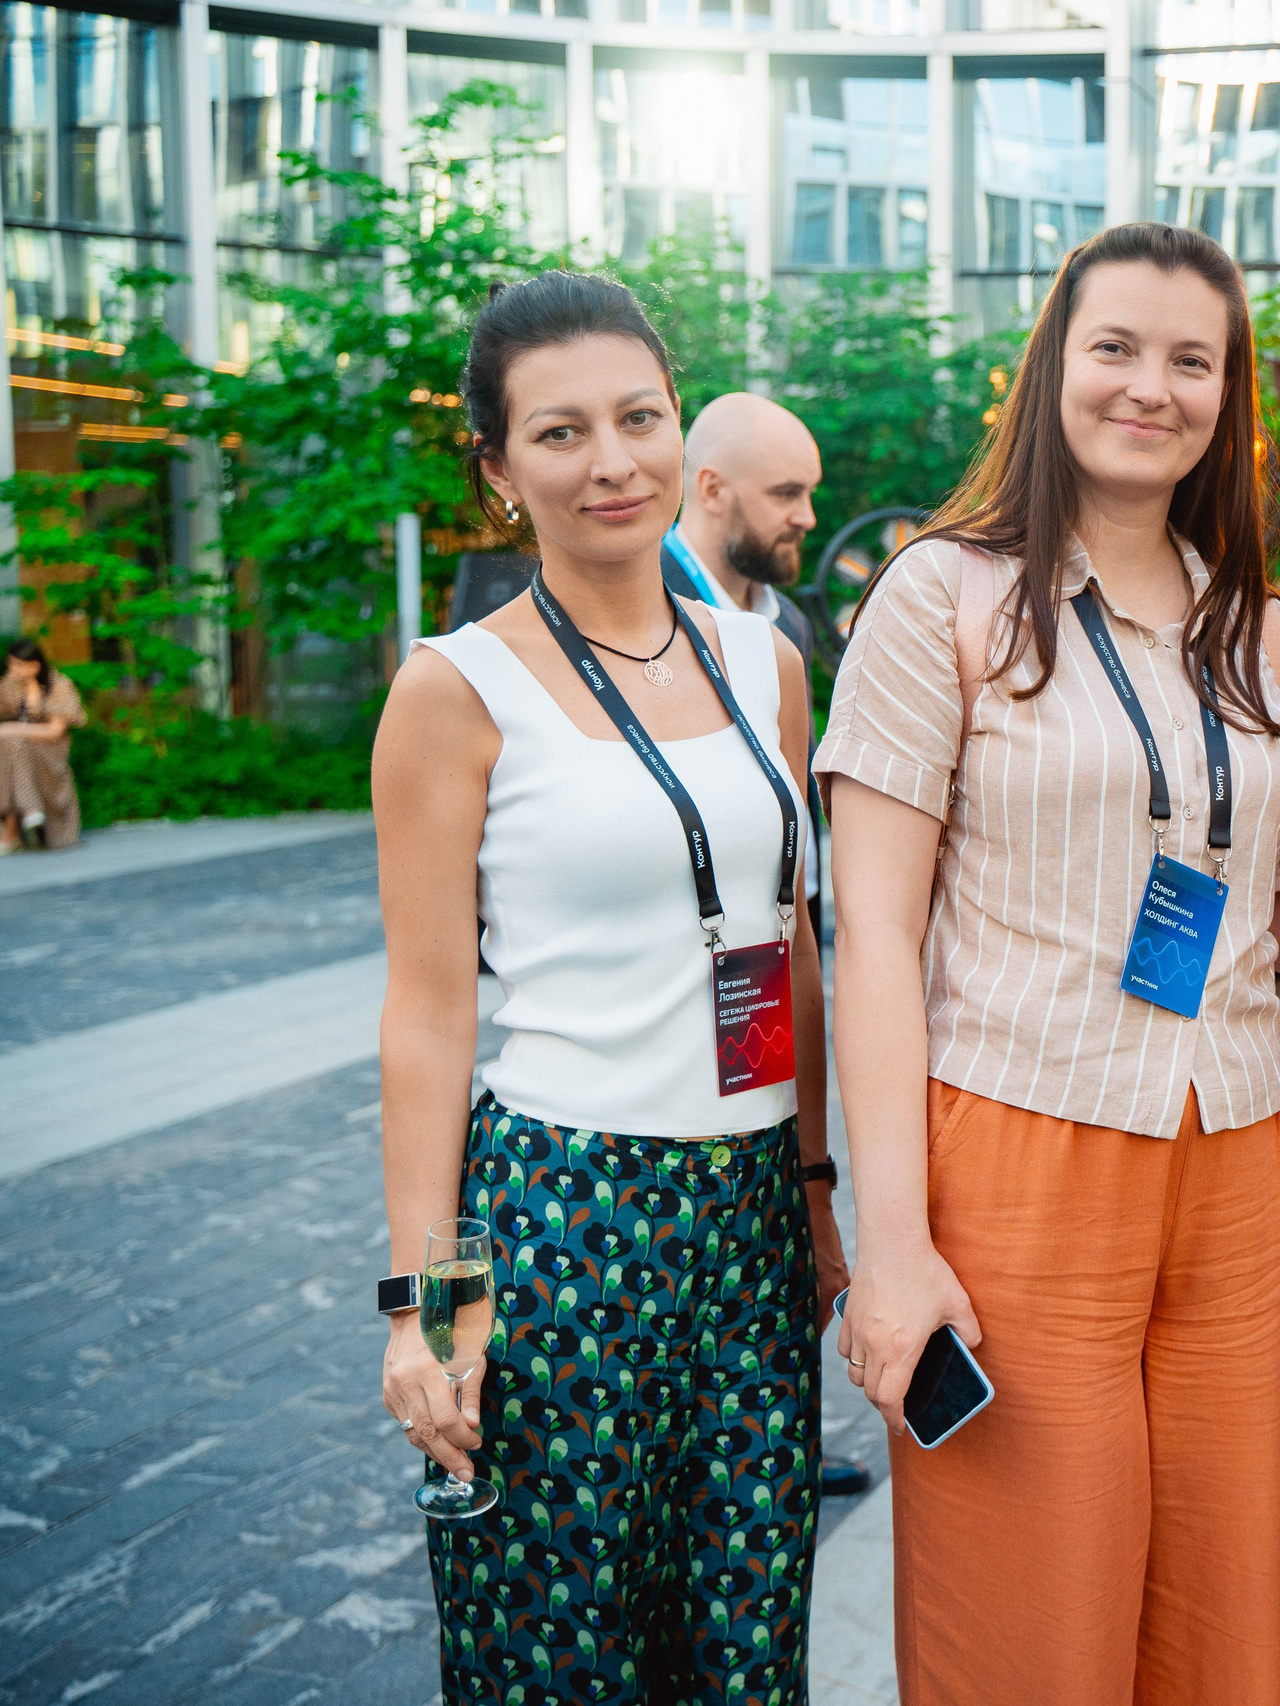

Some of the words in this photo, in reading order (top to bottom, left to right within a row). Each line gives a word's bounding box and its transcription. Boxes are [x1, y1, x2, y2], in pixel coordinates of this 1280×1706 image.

[581, 659, 606, 691] Контур
[702, 649, 720, 679] Контур
[1095, 632, 1117, 669] искусство
[1113, 669, 1131, 699] бизнеса
[626, 724, 650, 754] бизнеса
[1145, 737, 1160, 772] Контур
[648, 753, 676, 789] искусство
[1215, 765, 1225, 801] Контур
[692, 830, 706, 869] Контур
[787, 821, 796, 858] Контур
[1151, 880, 1177, 899] Олеся
[1148, 891, 1194, 919] Кубышкина
[1143, 908, 1180, 929] ХОЛДИНГ
[1178, 924, 1198, 939] АКВА
[718, 977, 751, 990] Евгения
[718, 987, 762, 1003] Лозинская
[1131, 974, 1159, 991] участник
[719, 1006, 745, 1018] СЕГЕЖА
[719, 1013, 751, 1026] РЕШЕНИЯ
[725, 1072, 753, 1086] участник
